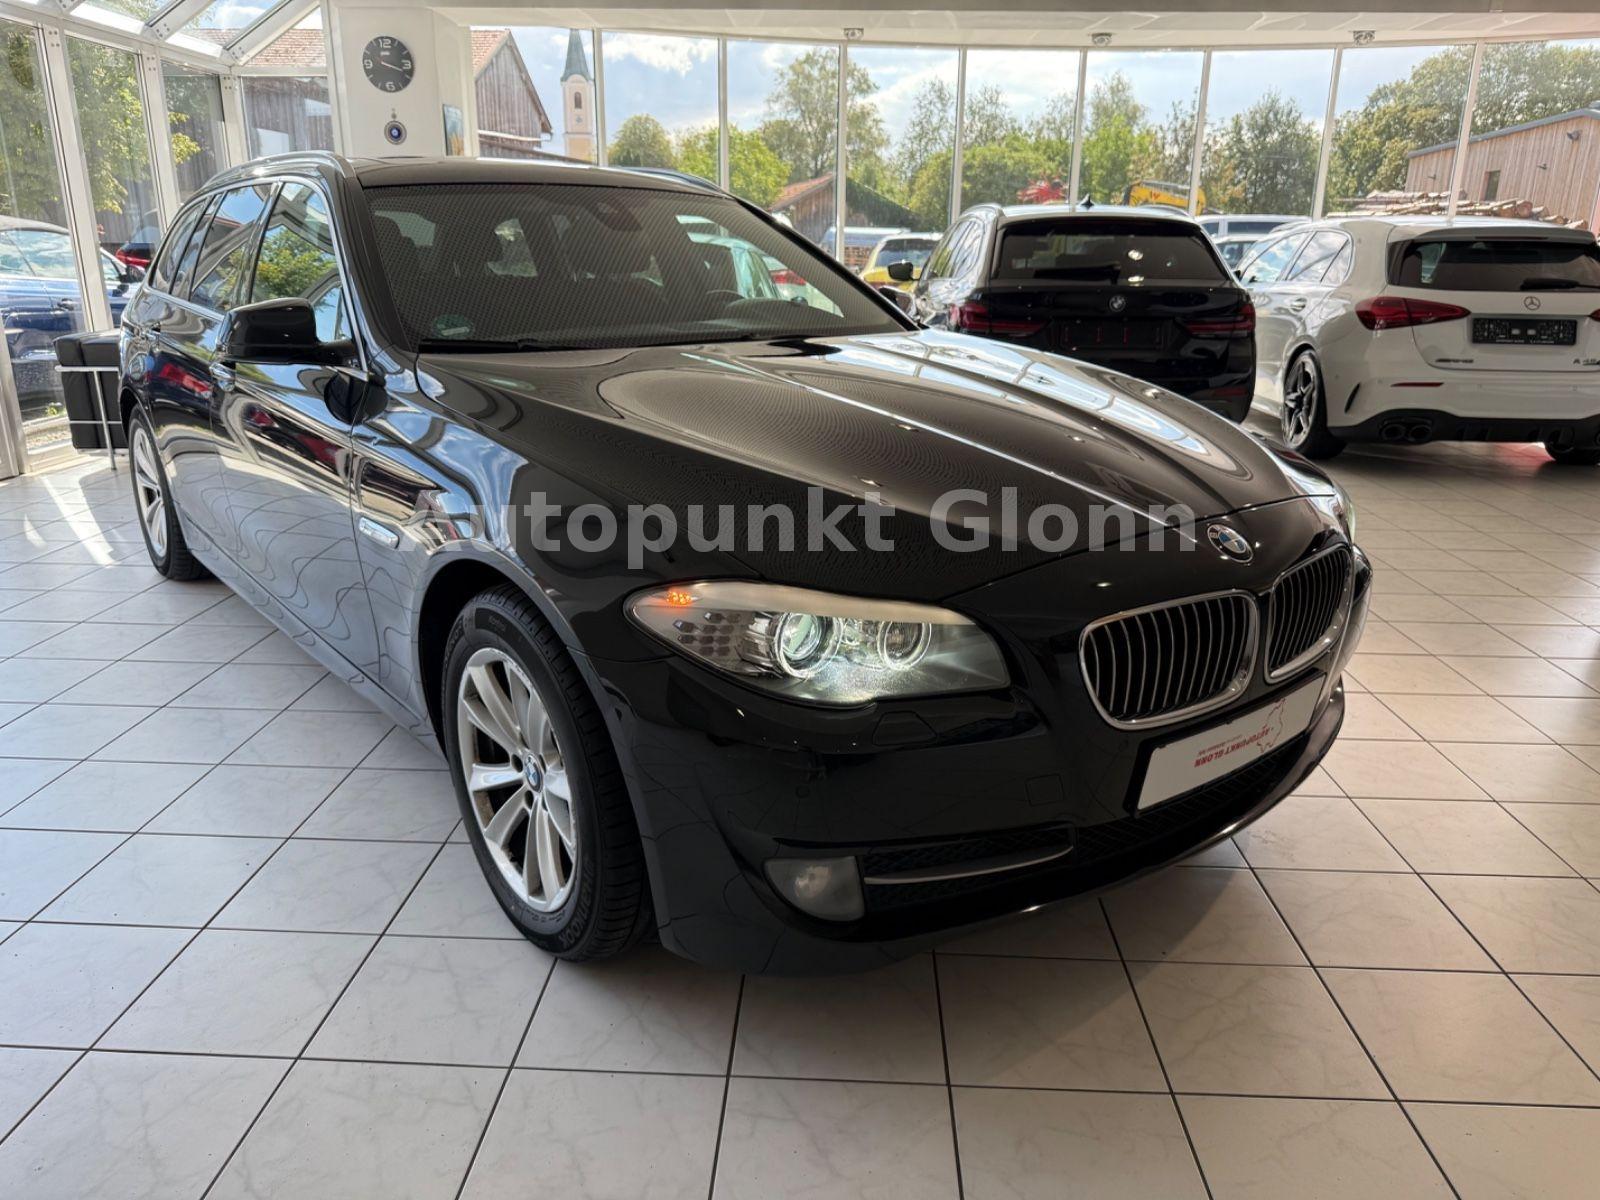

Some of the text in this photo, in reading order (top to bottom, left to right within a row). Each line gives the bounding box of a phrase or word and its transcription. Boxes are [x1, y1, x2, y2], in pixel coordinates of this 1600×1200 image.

[378, 38, 391, 48] 12
[364, 59, 373, 69] 9
[401, 60, 411, 69] 3
[385, 81, 396, 91] 6
